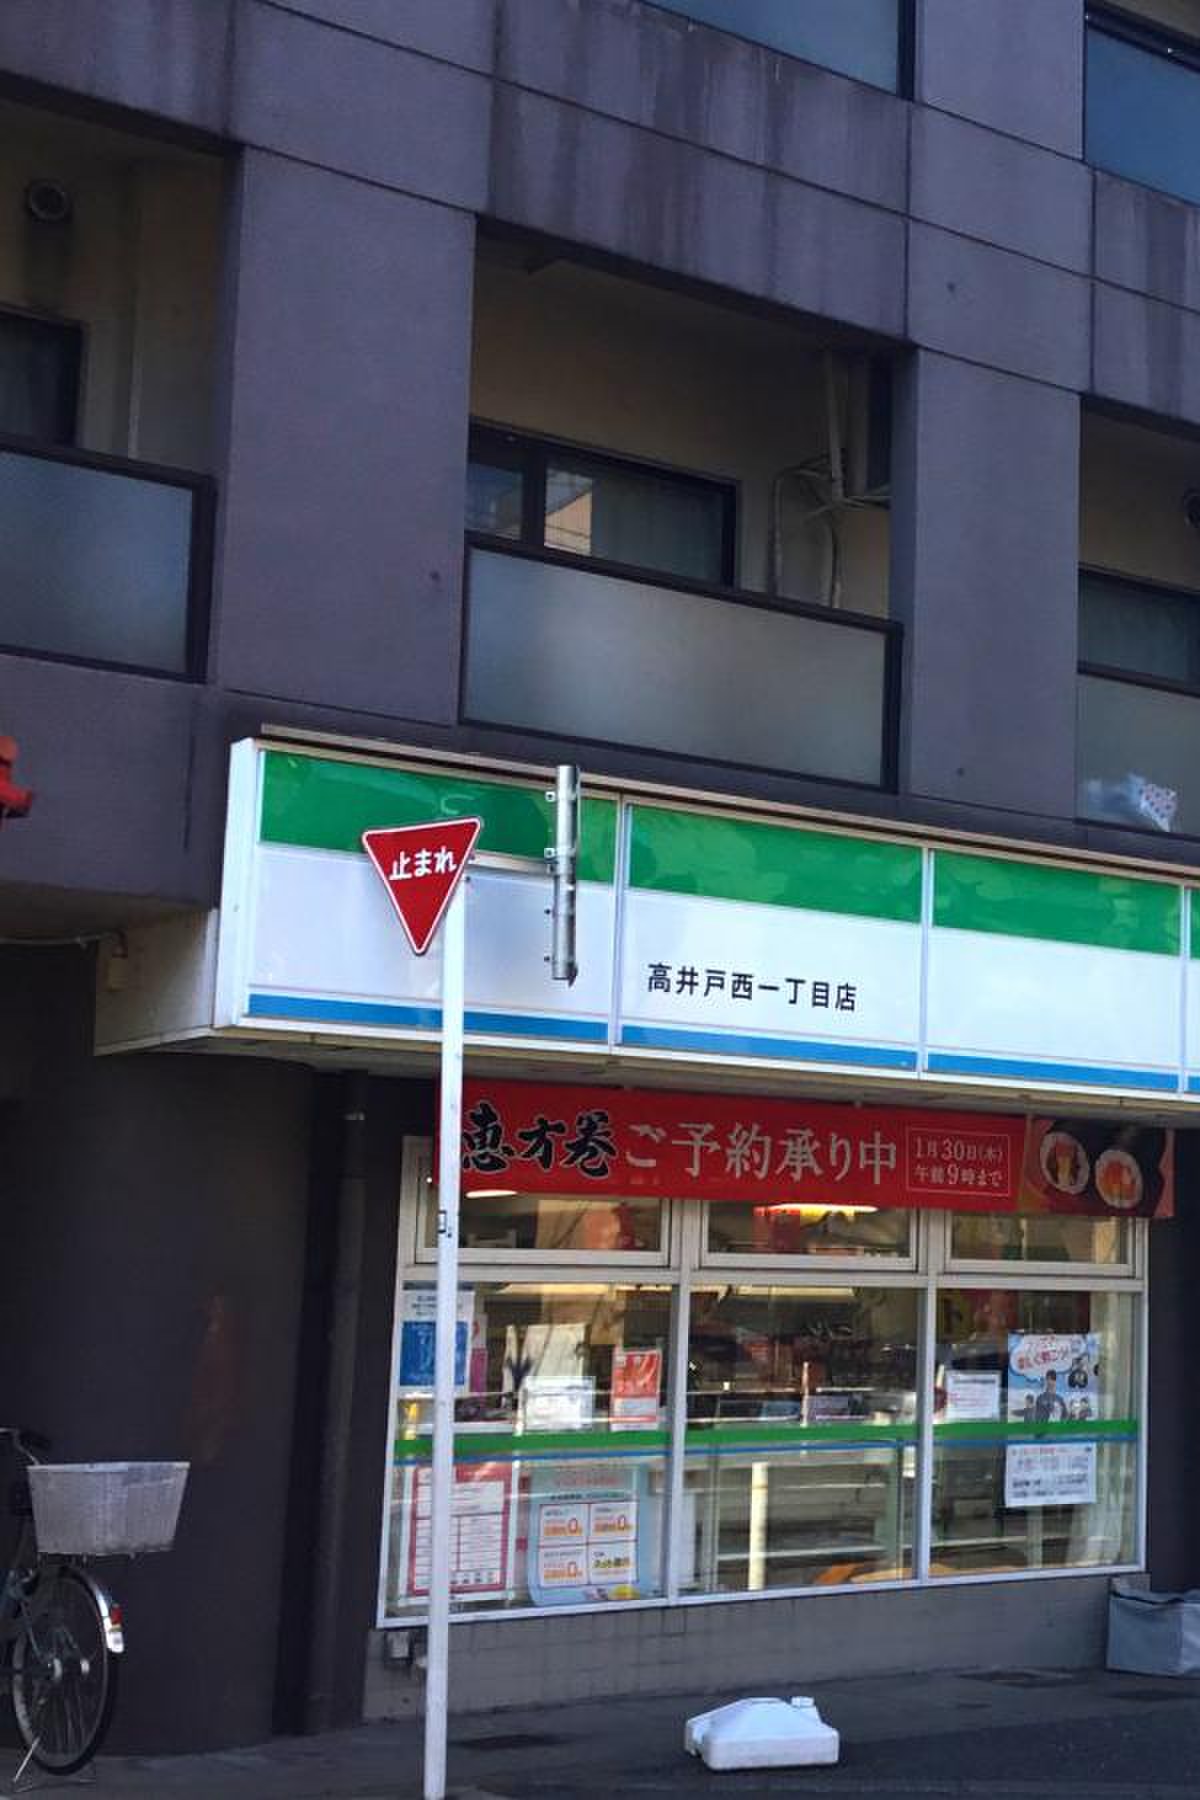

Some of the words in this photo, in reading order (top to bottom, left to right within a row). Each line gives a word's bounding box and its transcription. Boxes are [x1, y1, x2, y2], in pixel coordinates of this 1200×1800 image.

[388, 846, 458, 881] 止まれ
[647, 962, 859, 1012] 高井戸西一丁目店
[625, 1120, 897, 1185] ご予約承り中
